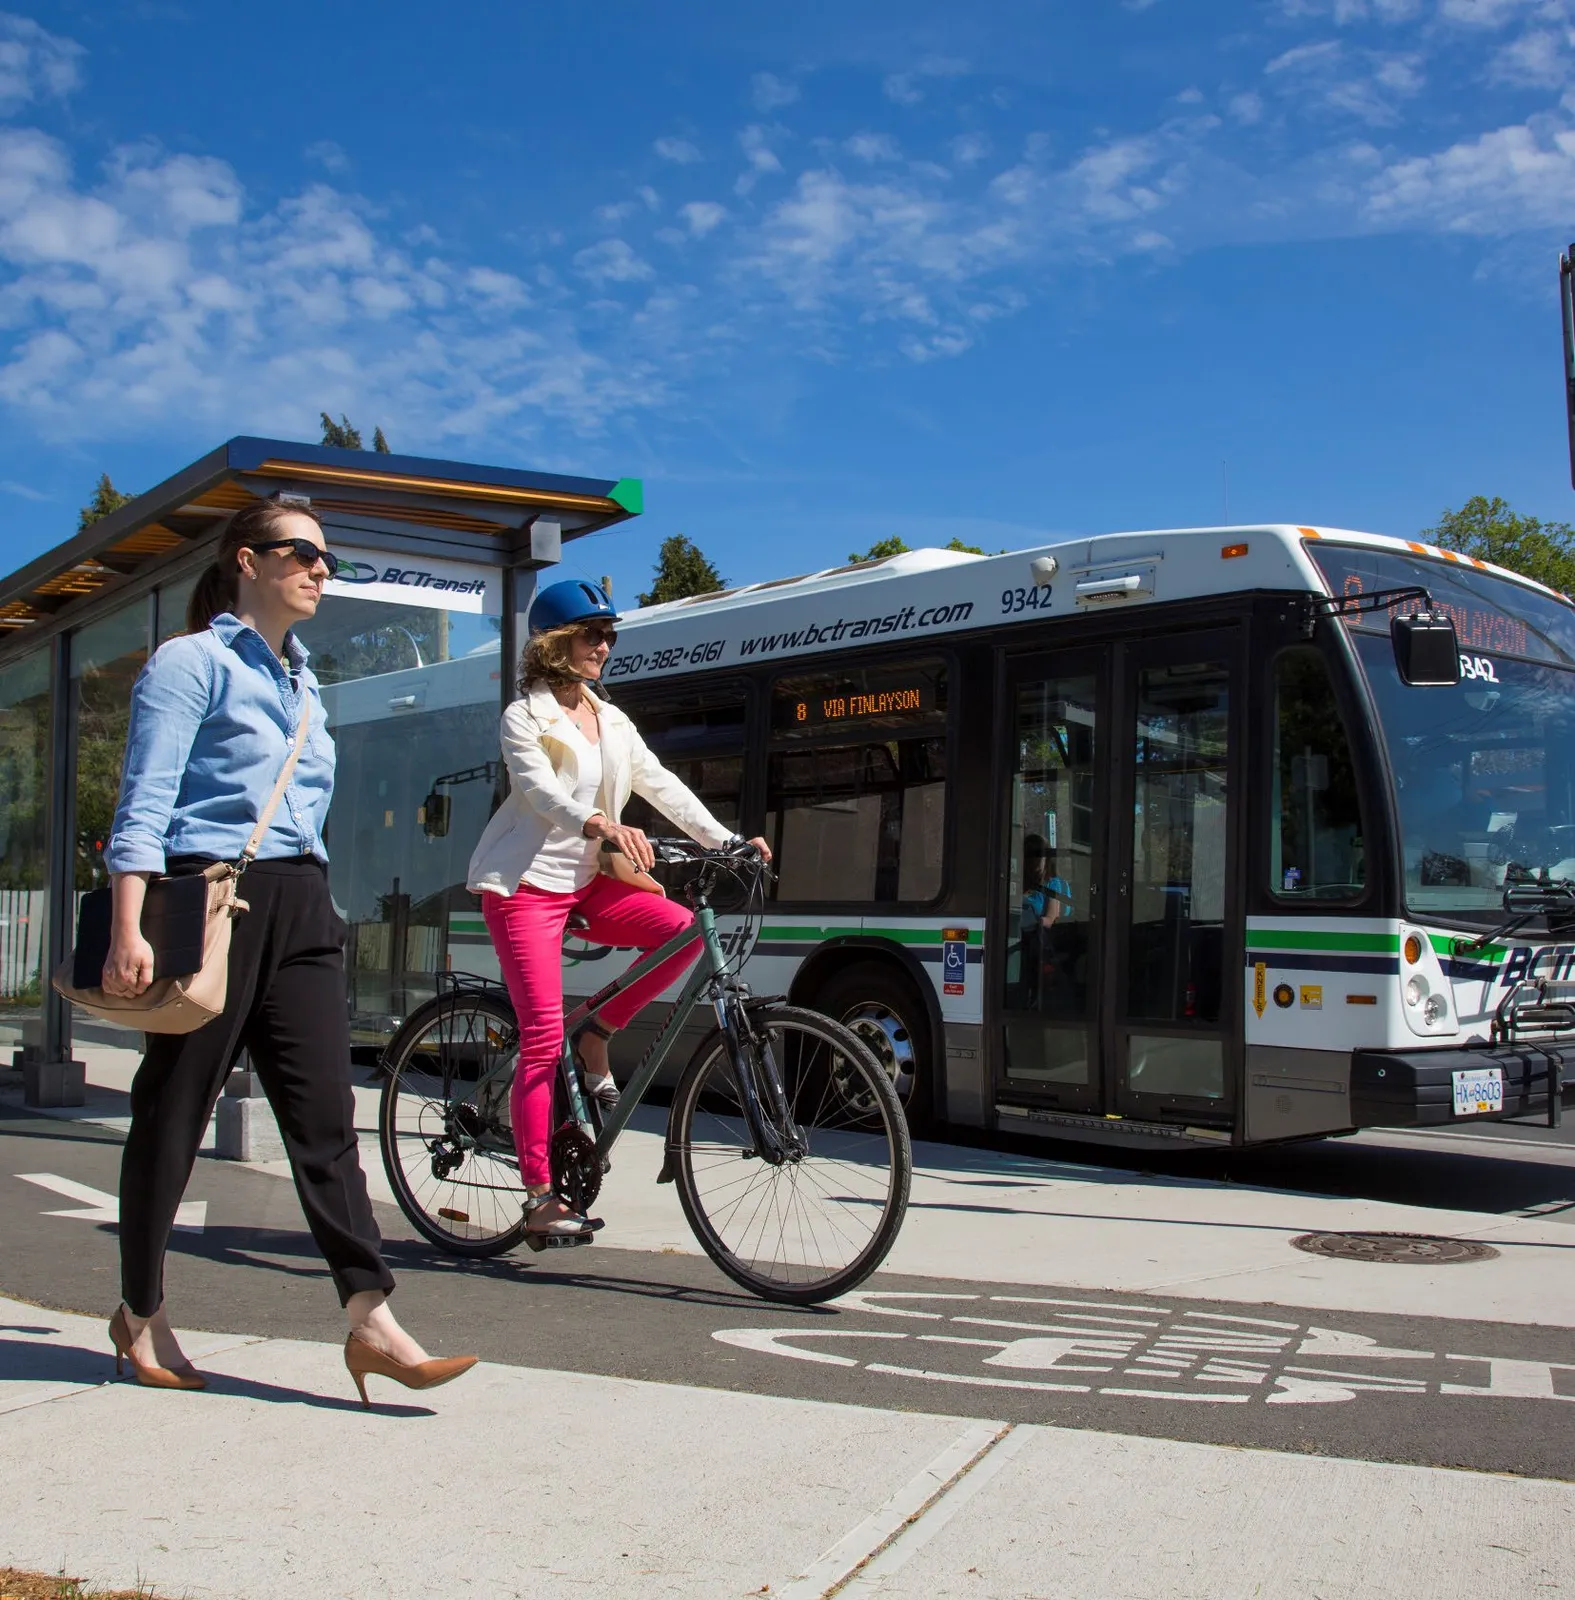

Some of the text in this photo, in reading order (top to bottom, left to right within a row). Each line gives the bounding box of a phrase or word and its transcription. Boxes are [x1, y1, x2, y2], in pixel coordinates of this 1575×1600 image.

[380, 567, 486, 595] BCTransit
[1001, 583, 1052, 614] 9342
[740, 602, 974, 656] www.bctransit.com
[796, 689, 920, 721] 8 VIA FINLAYSON
